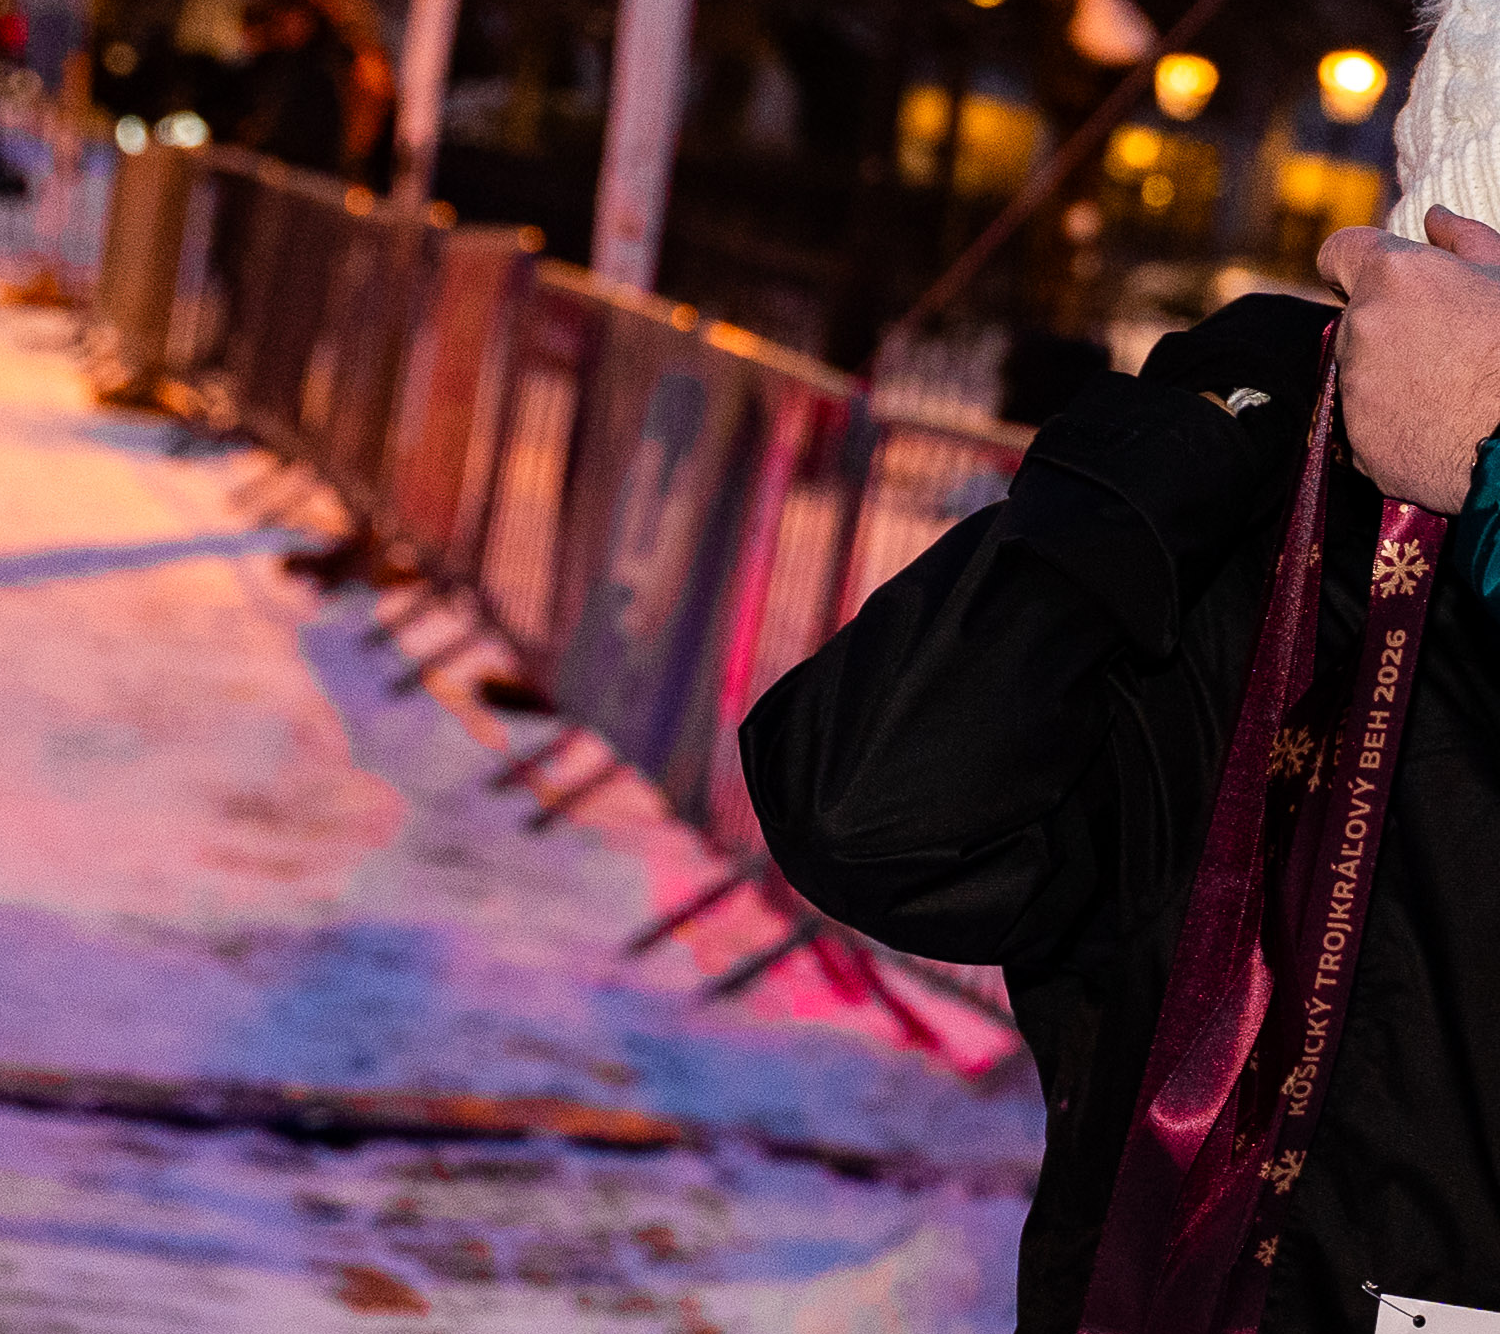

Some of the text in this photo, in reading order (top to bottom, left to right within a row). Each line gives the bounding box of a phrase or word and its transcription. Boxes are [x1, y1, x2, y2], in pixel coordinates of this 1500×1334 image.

[1373, 629, 1407, 703] 2026
[1359, 710, 1391, 769] BEH
[1314, 776, 1376, 990] TROJKRÁĽOVÝ
